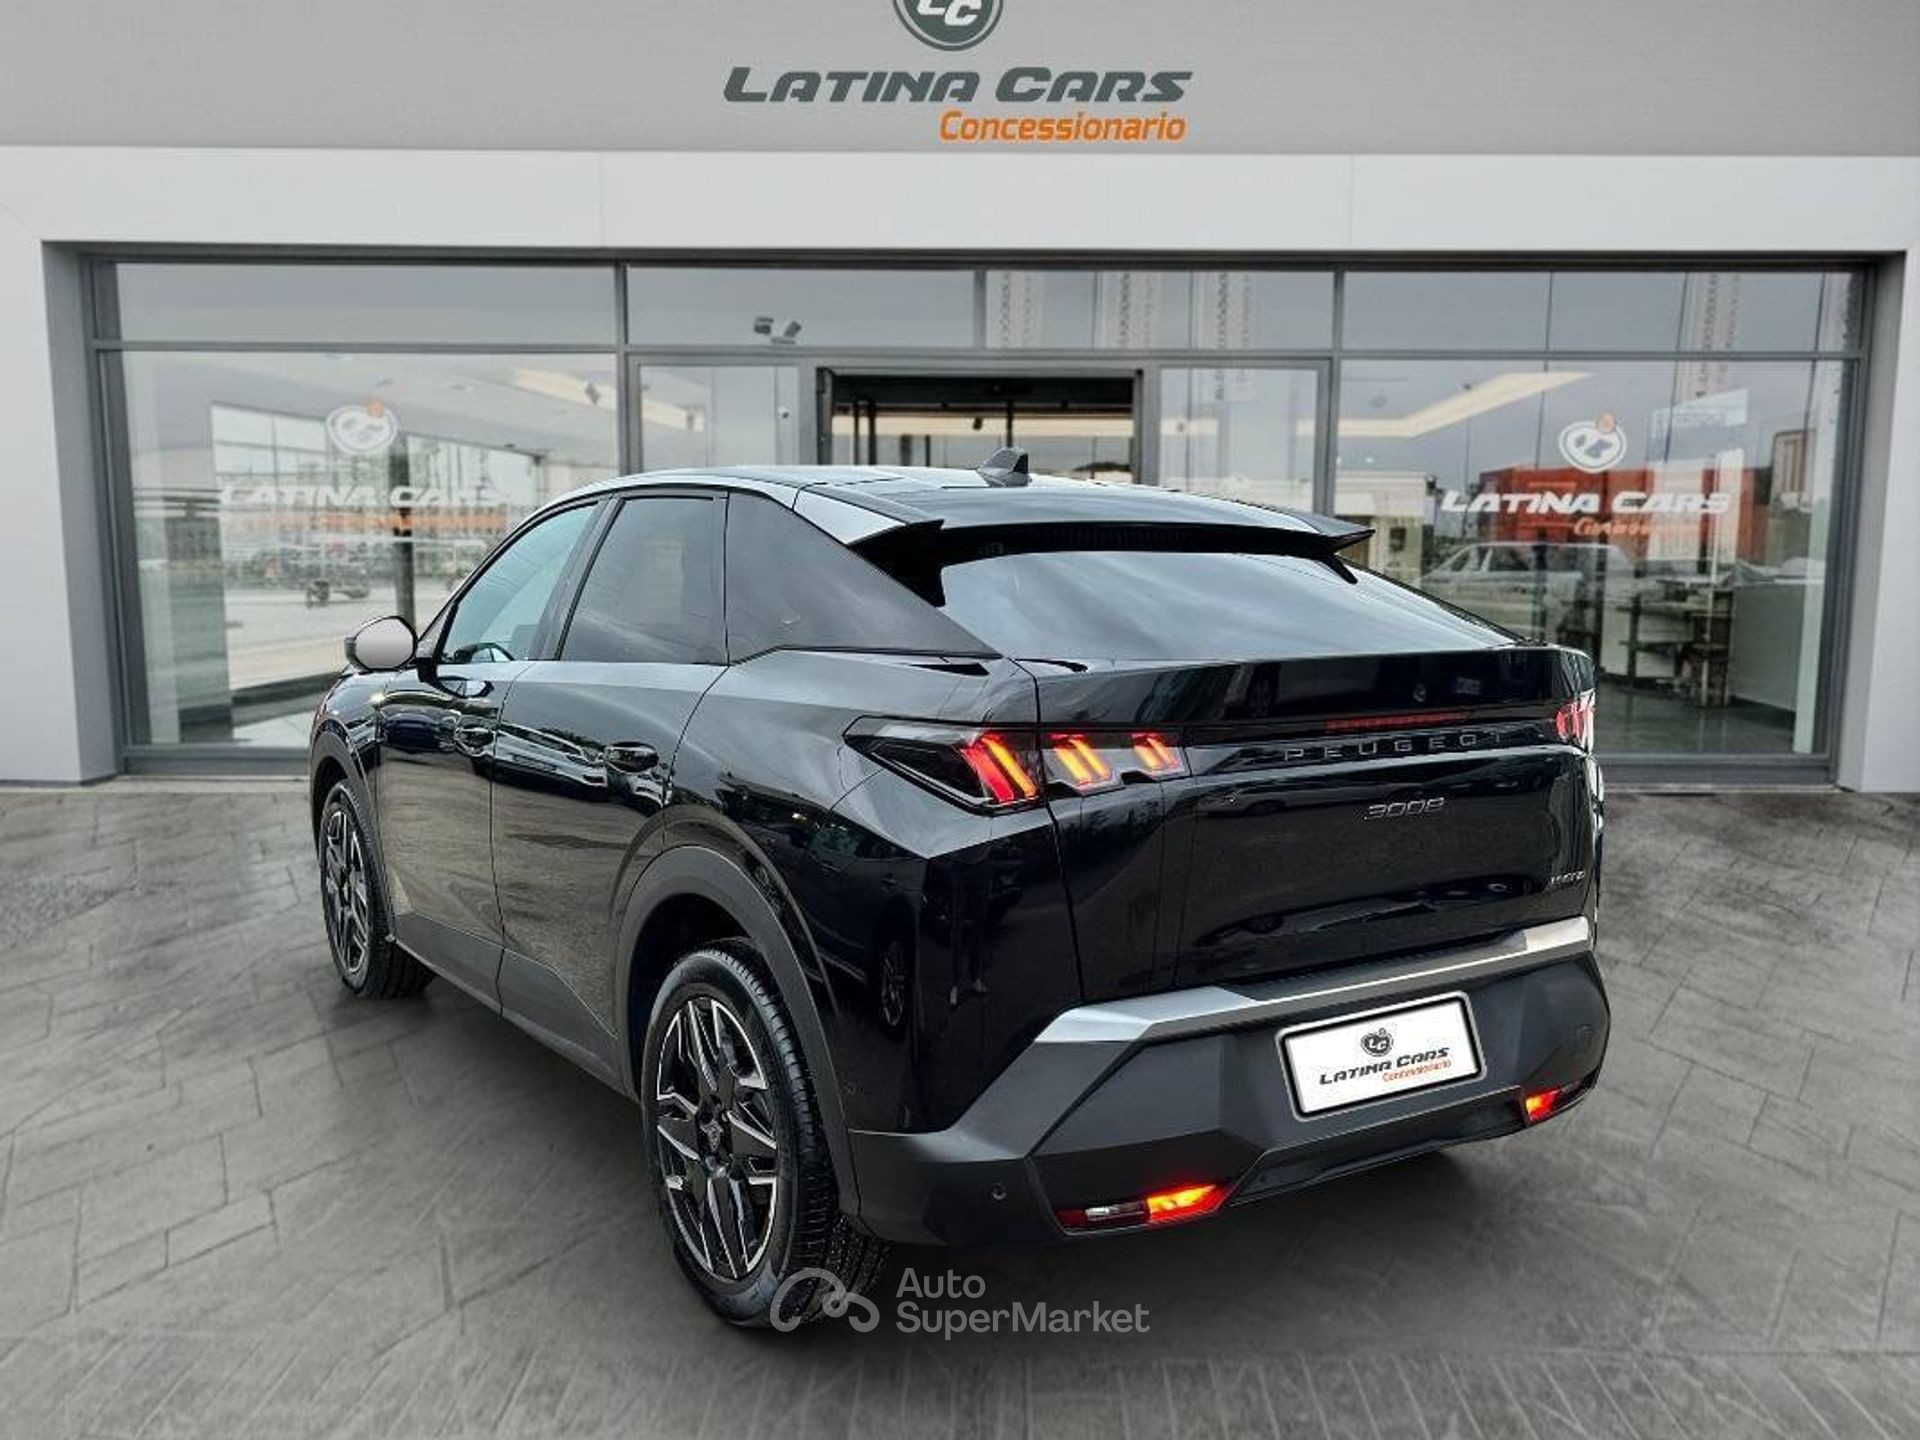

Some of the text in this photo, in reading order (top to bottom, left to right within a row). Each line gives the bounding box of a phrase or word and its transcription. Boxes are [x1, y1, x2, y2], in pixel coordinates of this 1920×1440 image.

[723, 67, 1193, 103] LATINA CARS
[939, 110, 1187, 142] Concessionario
[1440, 490, 1601, 515] LATINA
[1284, 729, 1503, 762] PEUGEOT
[1363, 797, 1445, 820] 3008
[1319, 1047, 1451, 1085] LATINA CARS
